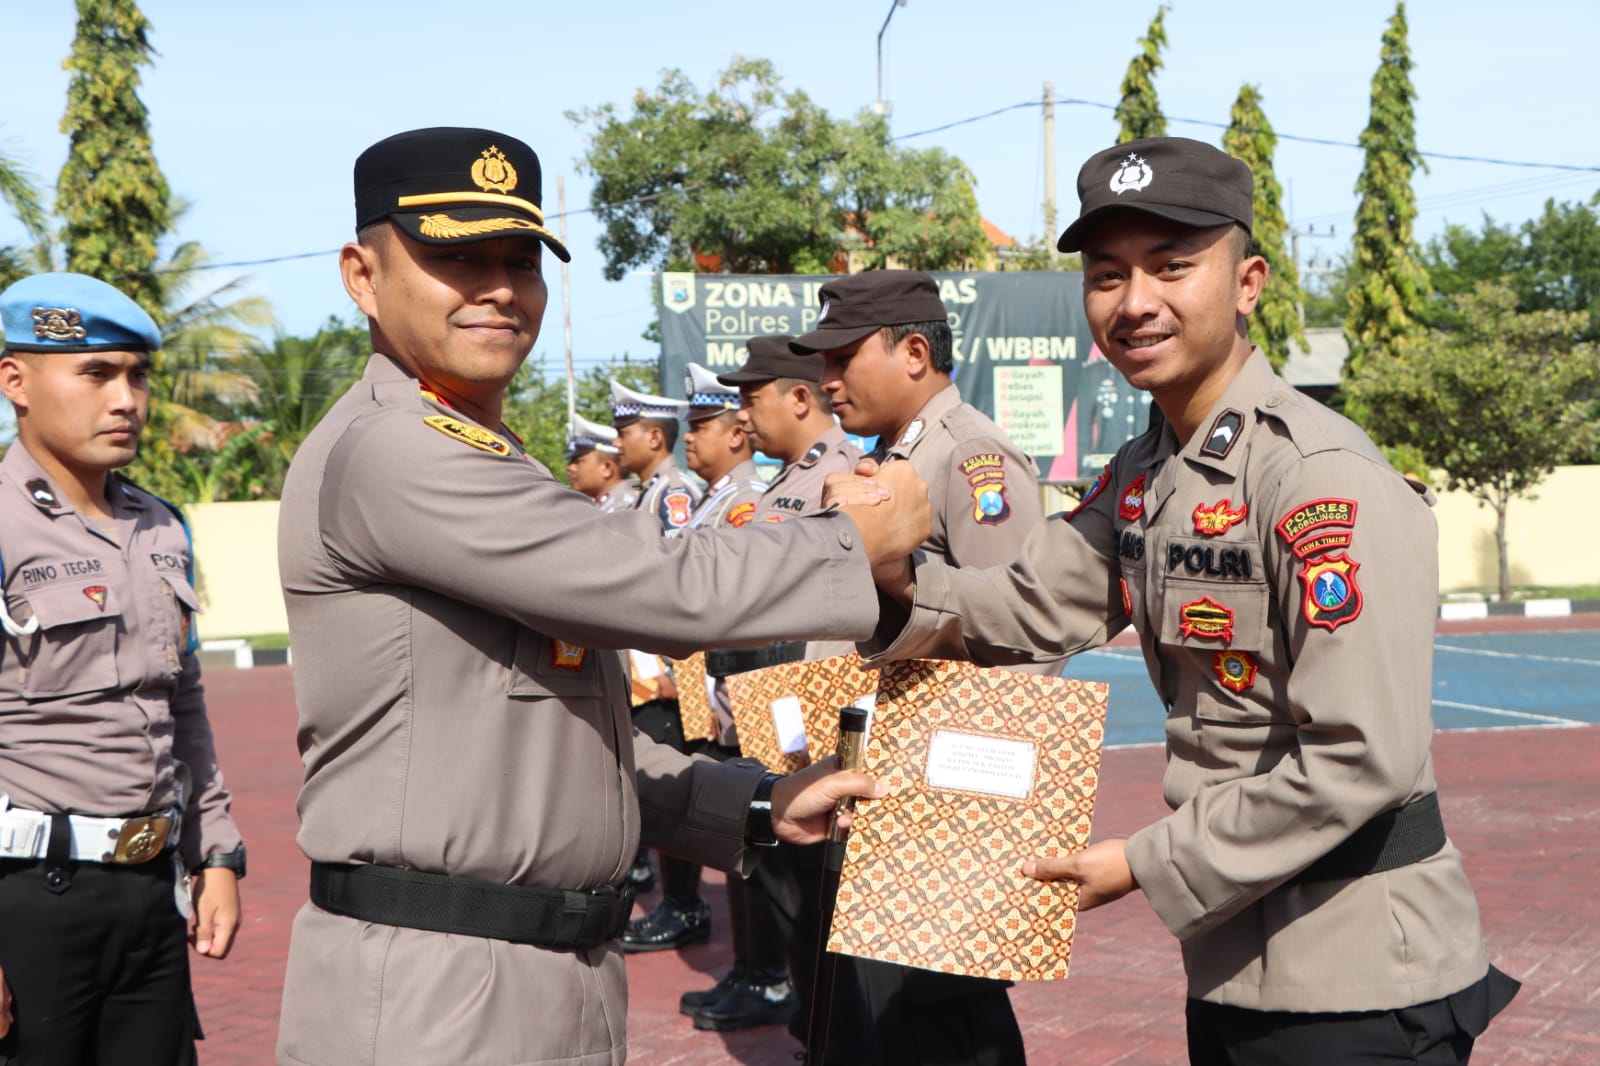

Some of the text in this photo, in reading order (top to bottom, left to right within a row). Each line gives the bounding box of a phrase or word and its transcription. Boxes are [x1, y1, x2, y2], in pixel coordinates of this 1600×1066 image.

[704, 282, 796, 307] ZONA
[705, 308, 790, 333] Polres
[986, 336, 1077, 360] WBBM
[772, 497, 806, 512] POLRI
[1284, 503, 1348, 531] POLRES
[1289, 512, 1348, 537] PROBOLINGGO
[1300, 536, 1346, 552] JAWA TIMUR
[22, 559, 104, 585] RINO TEGAR
[1169, 542, 1252, 577] POLRI
